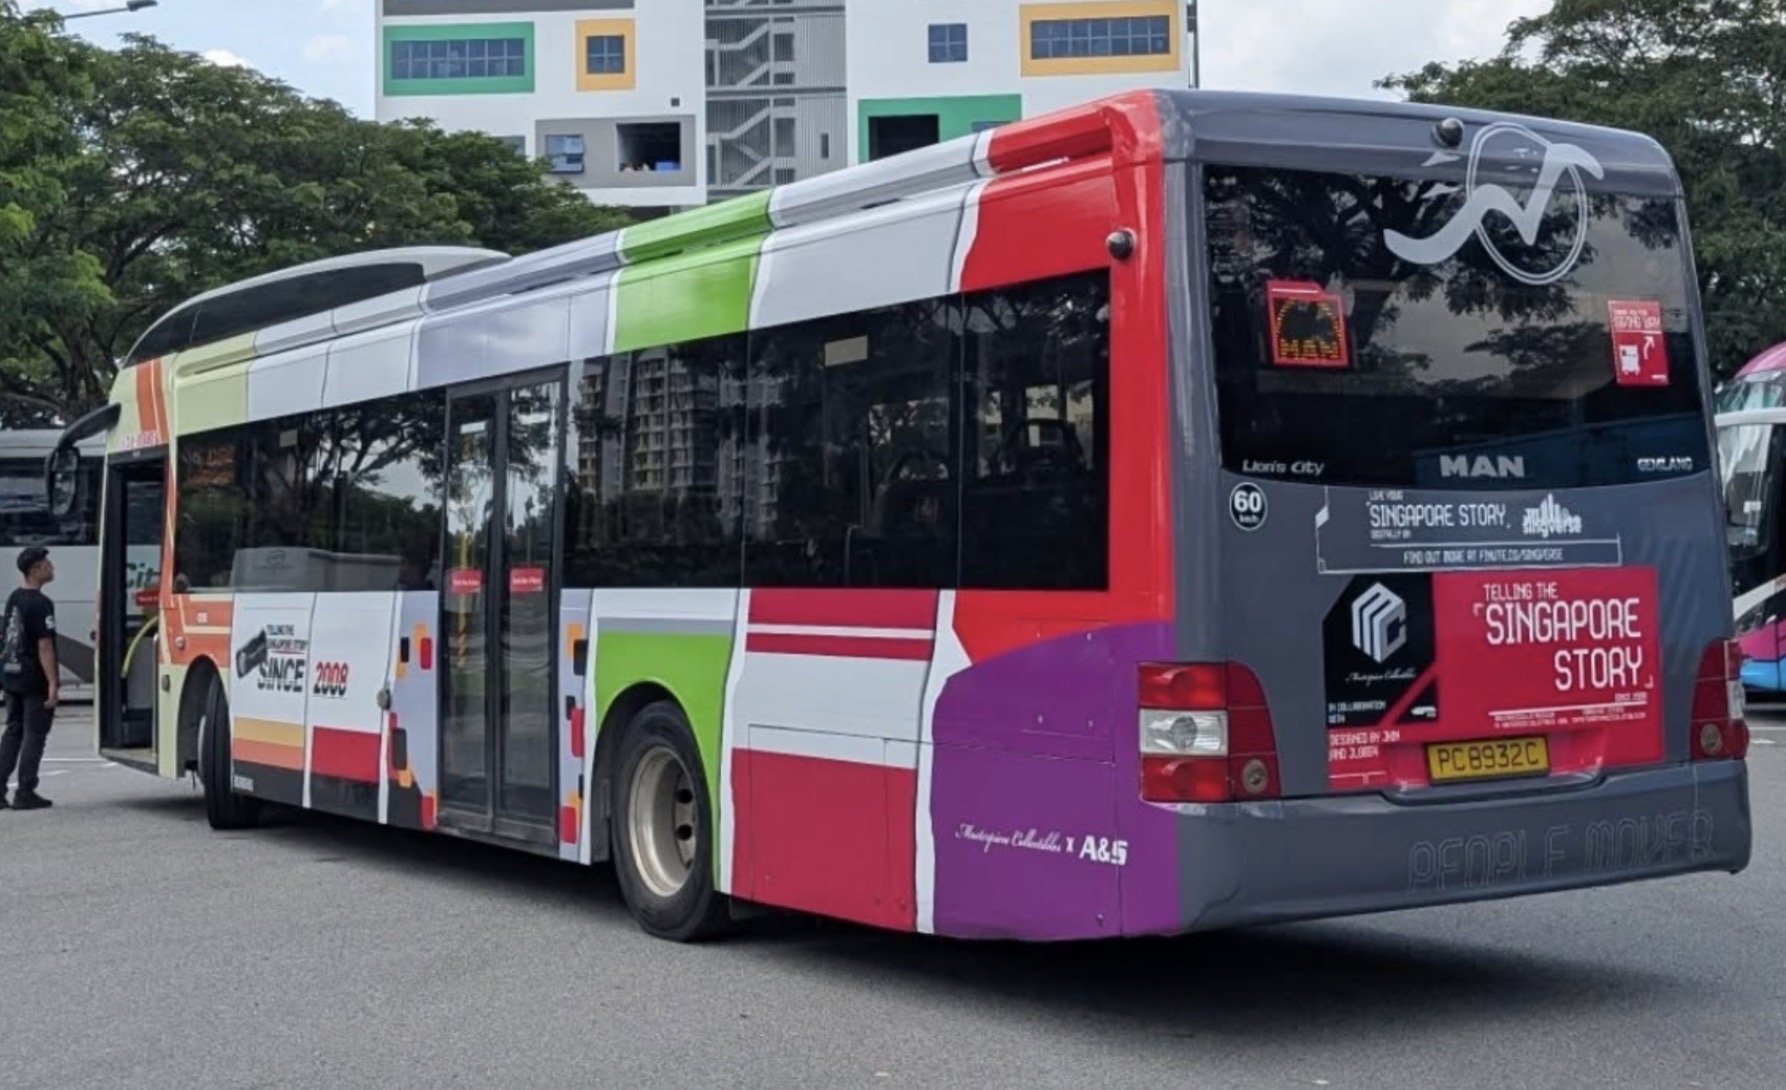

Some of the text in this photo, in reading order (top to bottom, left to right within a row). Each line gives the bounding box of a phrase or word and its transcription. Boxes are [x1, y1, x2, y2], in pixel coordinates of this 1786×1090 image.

[1242, 459, 1325, 476] Lion's City
[1440, 454, 1524, 478] MAN
[1233, 490, 1262, 513] 60
[1368, 503, 1455, 528] SINGAPORE
[1484, 581, 1559, 601] TELLING THE
[1486, 598, 1642, 645] SINGAPORE
[257, 657, 349, 696] SINCE 2008
[1554, 645, 1643, 691] STORY
[1437, 741, 1540, 773] PC8932C
